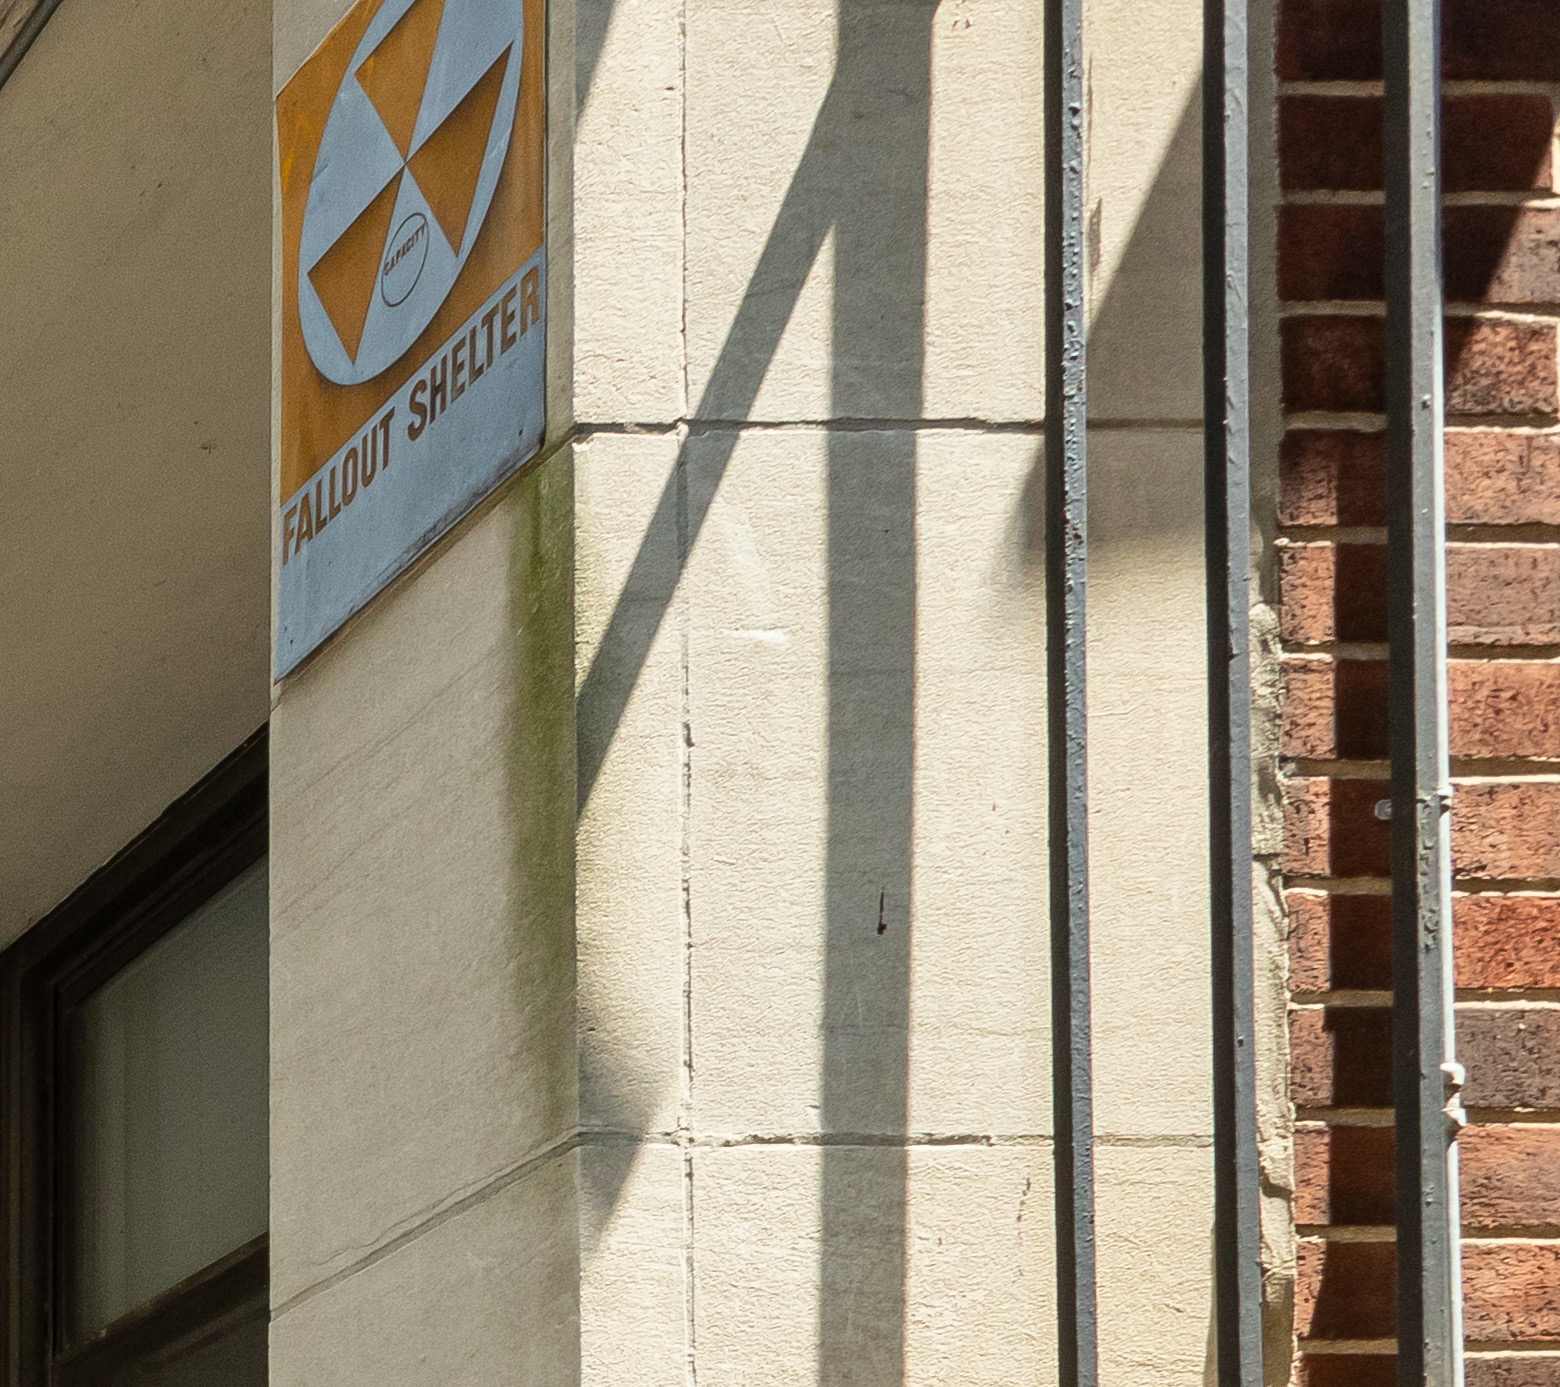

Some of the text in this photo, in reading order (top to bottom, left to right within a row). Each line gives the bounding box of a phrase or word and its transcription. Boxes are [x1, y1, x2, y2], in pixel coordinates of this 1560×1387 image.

[383, 222, 426, 276] CAPACITY
[281, 265, 540, 566] FALLOUT SHELTER
